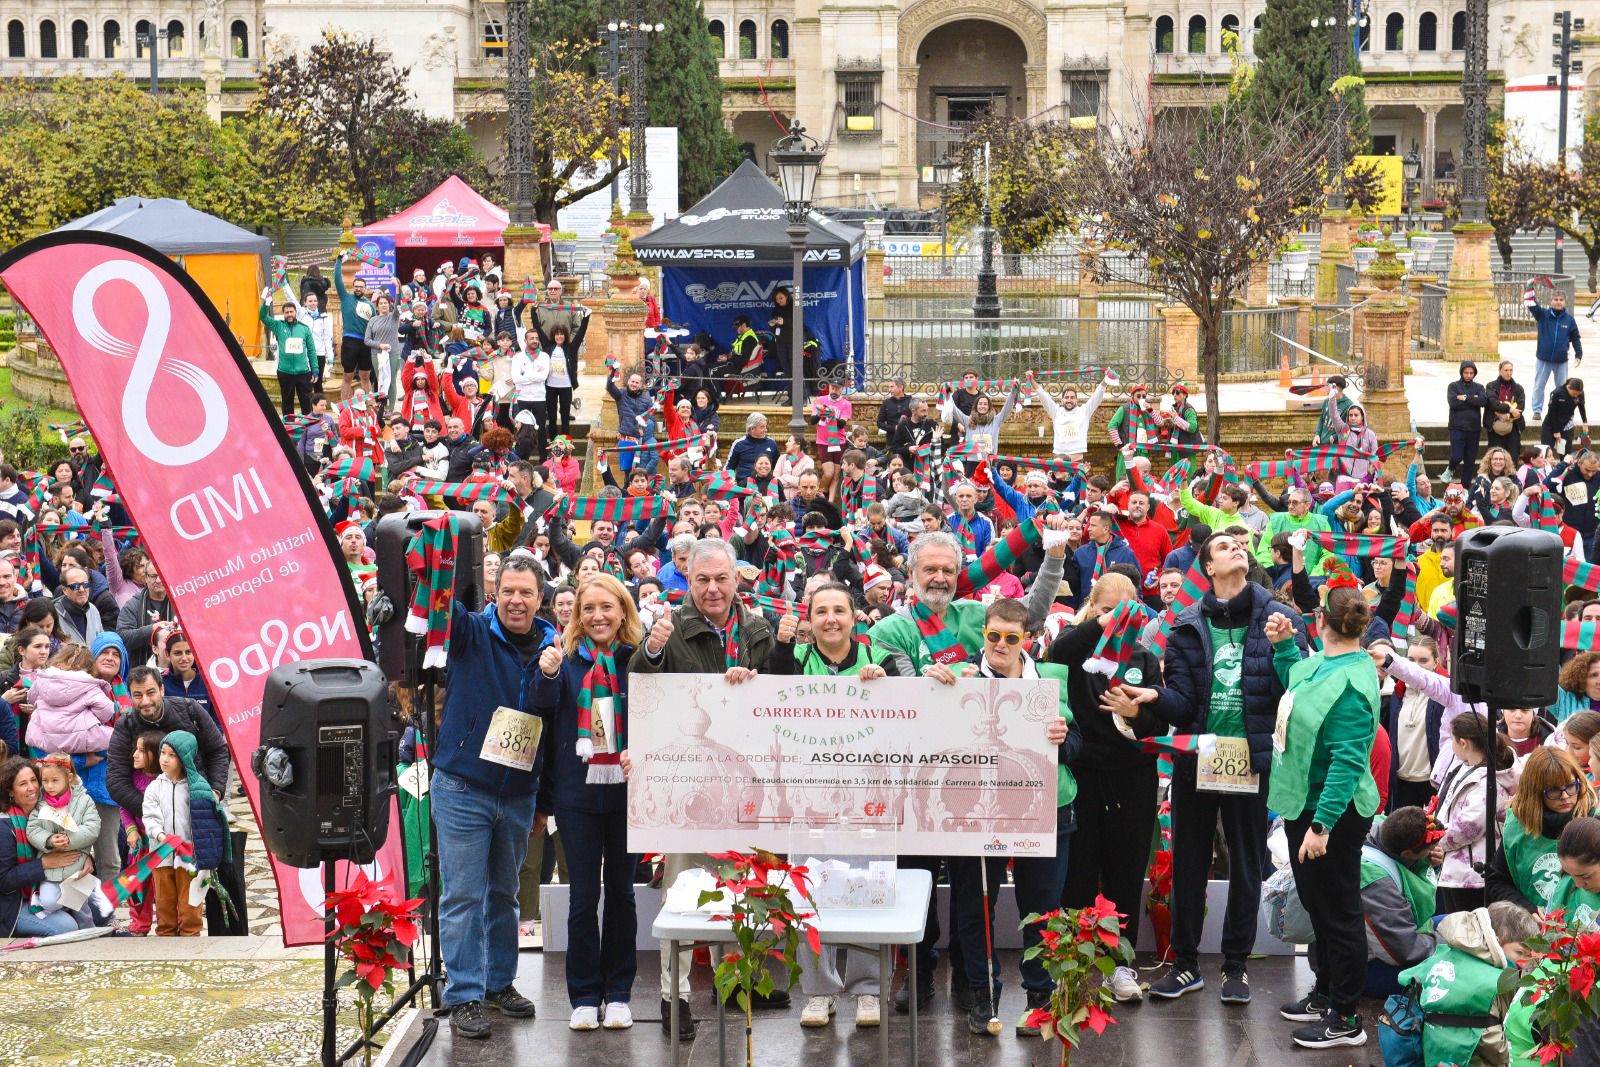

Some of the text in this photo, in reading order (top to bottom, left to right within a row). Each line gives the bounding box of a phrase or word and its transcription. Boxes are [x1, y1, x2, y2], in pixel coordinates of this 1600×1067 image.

[635, 248, 755, 259] WWW.AVSPRO.ES
[802, 248, 842, 261] AVS
[705, 301, 776, 311] PROFESSIONA
[846, 684, 871, 701] DE
[752, 707, 918, 720] CARRERA DE NAVIDAD
[499, 730, 531, 754] 387
[772, 724, 875, 747] SOLIDARIDAD
[705, 753, 715, 763] A
[717, 753, 732, 763] LA
[735, 753, 779, 763] ORDEN
[918, 754, 999, 765] APASCIDE
[1212, 757, 1249, 777] 262
[646, 775, 669, 783] POR
[672, 775, 732, 784] CONCEPTO
[751, 776, 803, 785] Recaudación
[804, 777, 841, 785] obtenida
[854, 777, 866, 786] 3,5
[867, 777, 881, 786] km
[882, 777, 893, 786] de
[894, 777, 939, 786] solidaridad
[945, 779, 976, 787] Carrera
[977, 779, 988, 787] de
[989, 779, 1023, 788] Navidad
